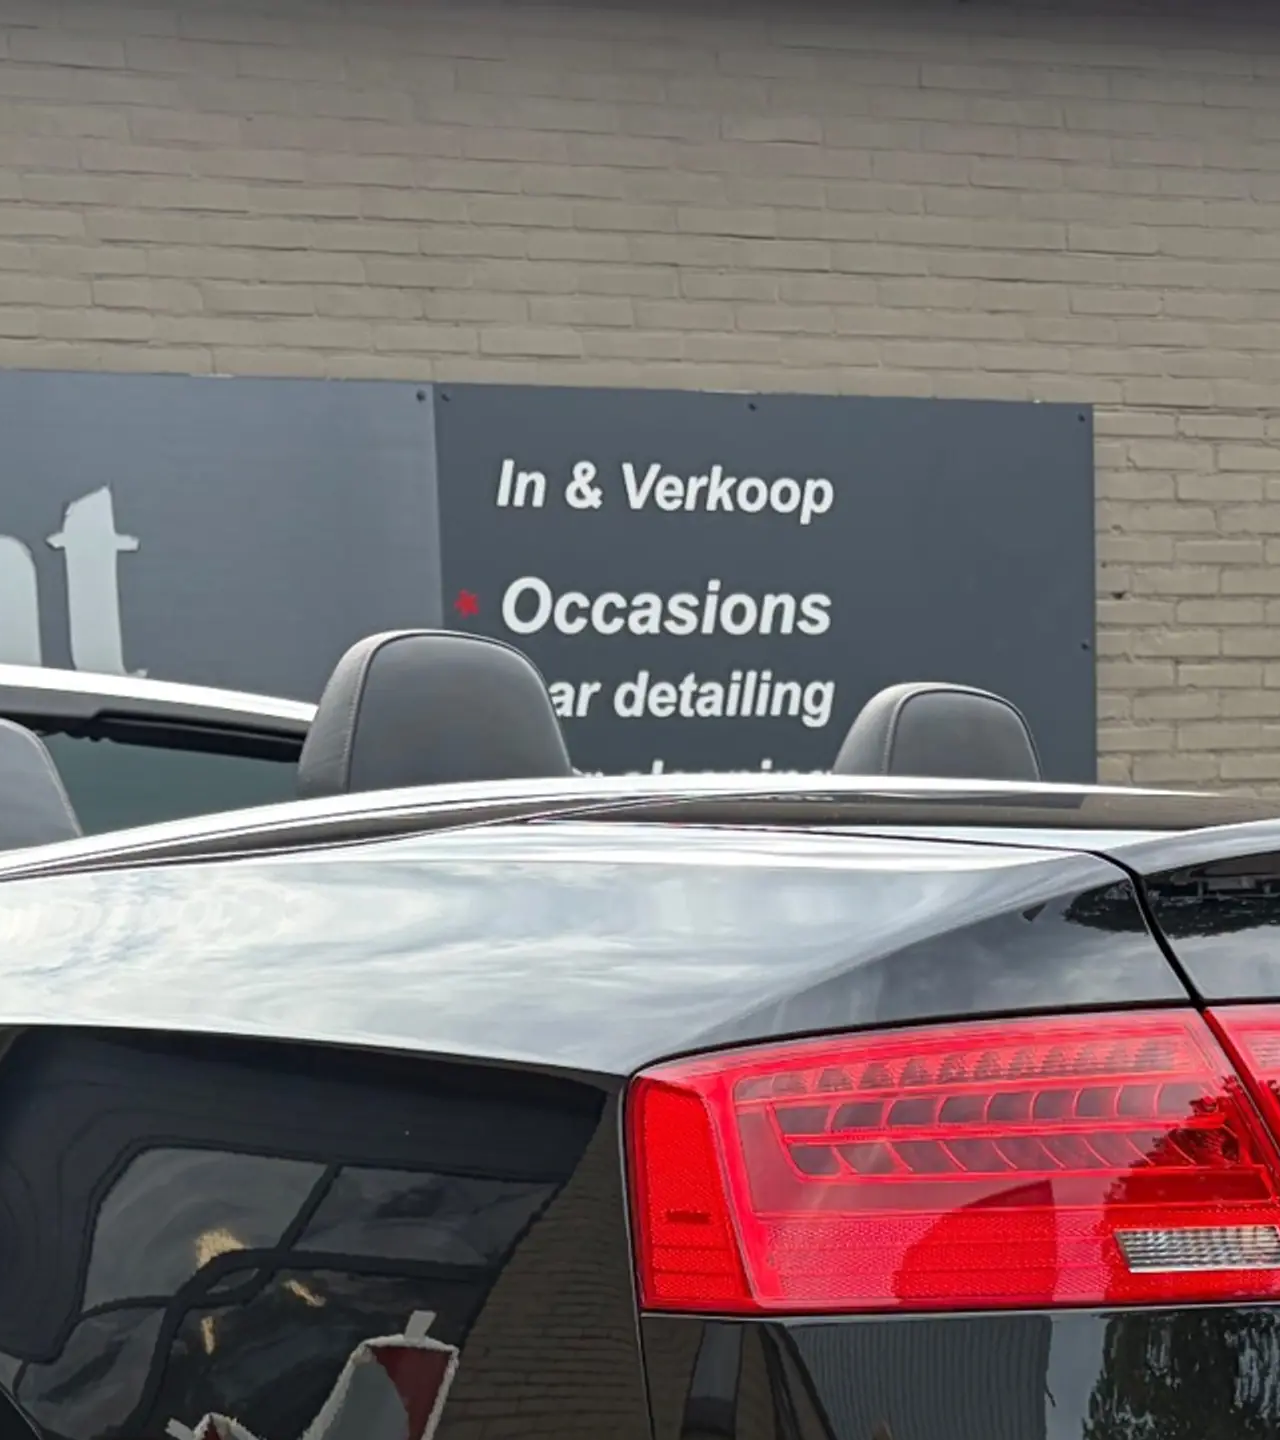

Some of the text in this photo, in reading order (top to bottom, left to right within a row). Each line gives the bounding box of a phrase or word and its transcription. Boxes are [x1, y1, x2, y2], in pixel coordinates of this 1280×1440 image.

[496, 459, 834, 525] In & Verkoop
[502, 576, 832, 636] Occasions
[548, 670, 835, 727] ar detailing
